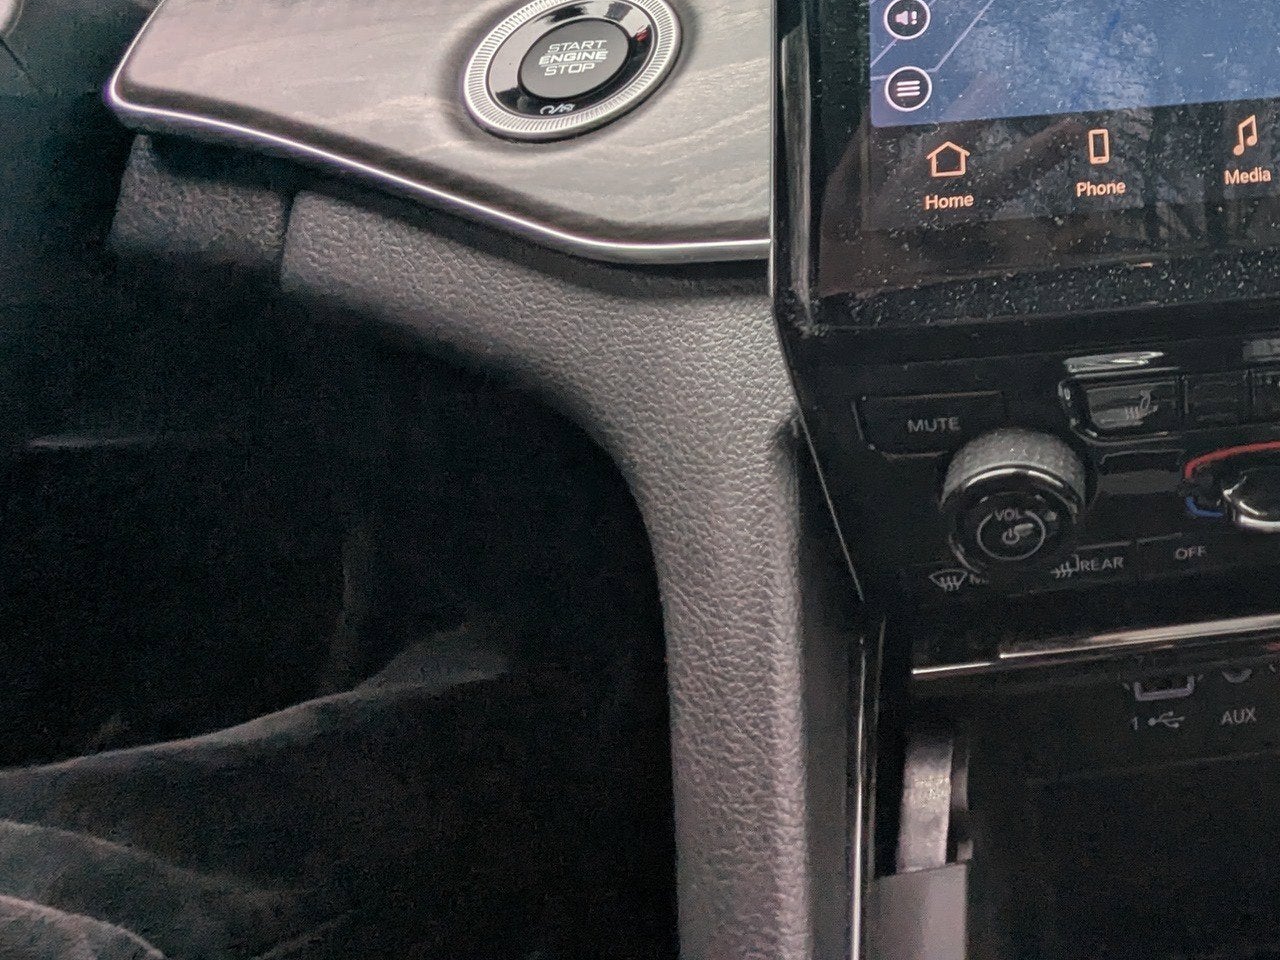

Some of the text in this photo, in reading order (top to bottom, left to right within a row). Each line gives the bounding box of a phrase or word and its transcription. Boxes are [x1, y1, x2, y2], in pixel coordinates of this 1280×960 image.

[548, 40, 608, 53] START
[538, 50, 609, 67] ENGINE
[544, 62, 596, 77] STOP
[1224, 165, 1272, 186] Media
[1076, 179, 1126, 198] Phone
[924, 192, 974, 211] Home
[907, 415, 960, 433] MUTE
[993, 508, 1023, 521] VOL
[1174, 545, 1207, 560] OFF
[1080, 556, 1125, 572] REAR
[1132, 715, 1140, 731] 1
[1220, 707, 1258, 726] AUX
